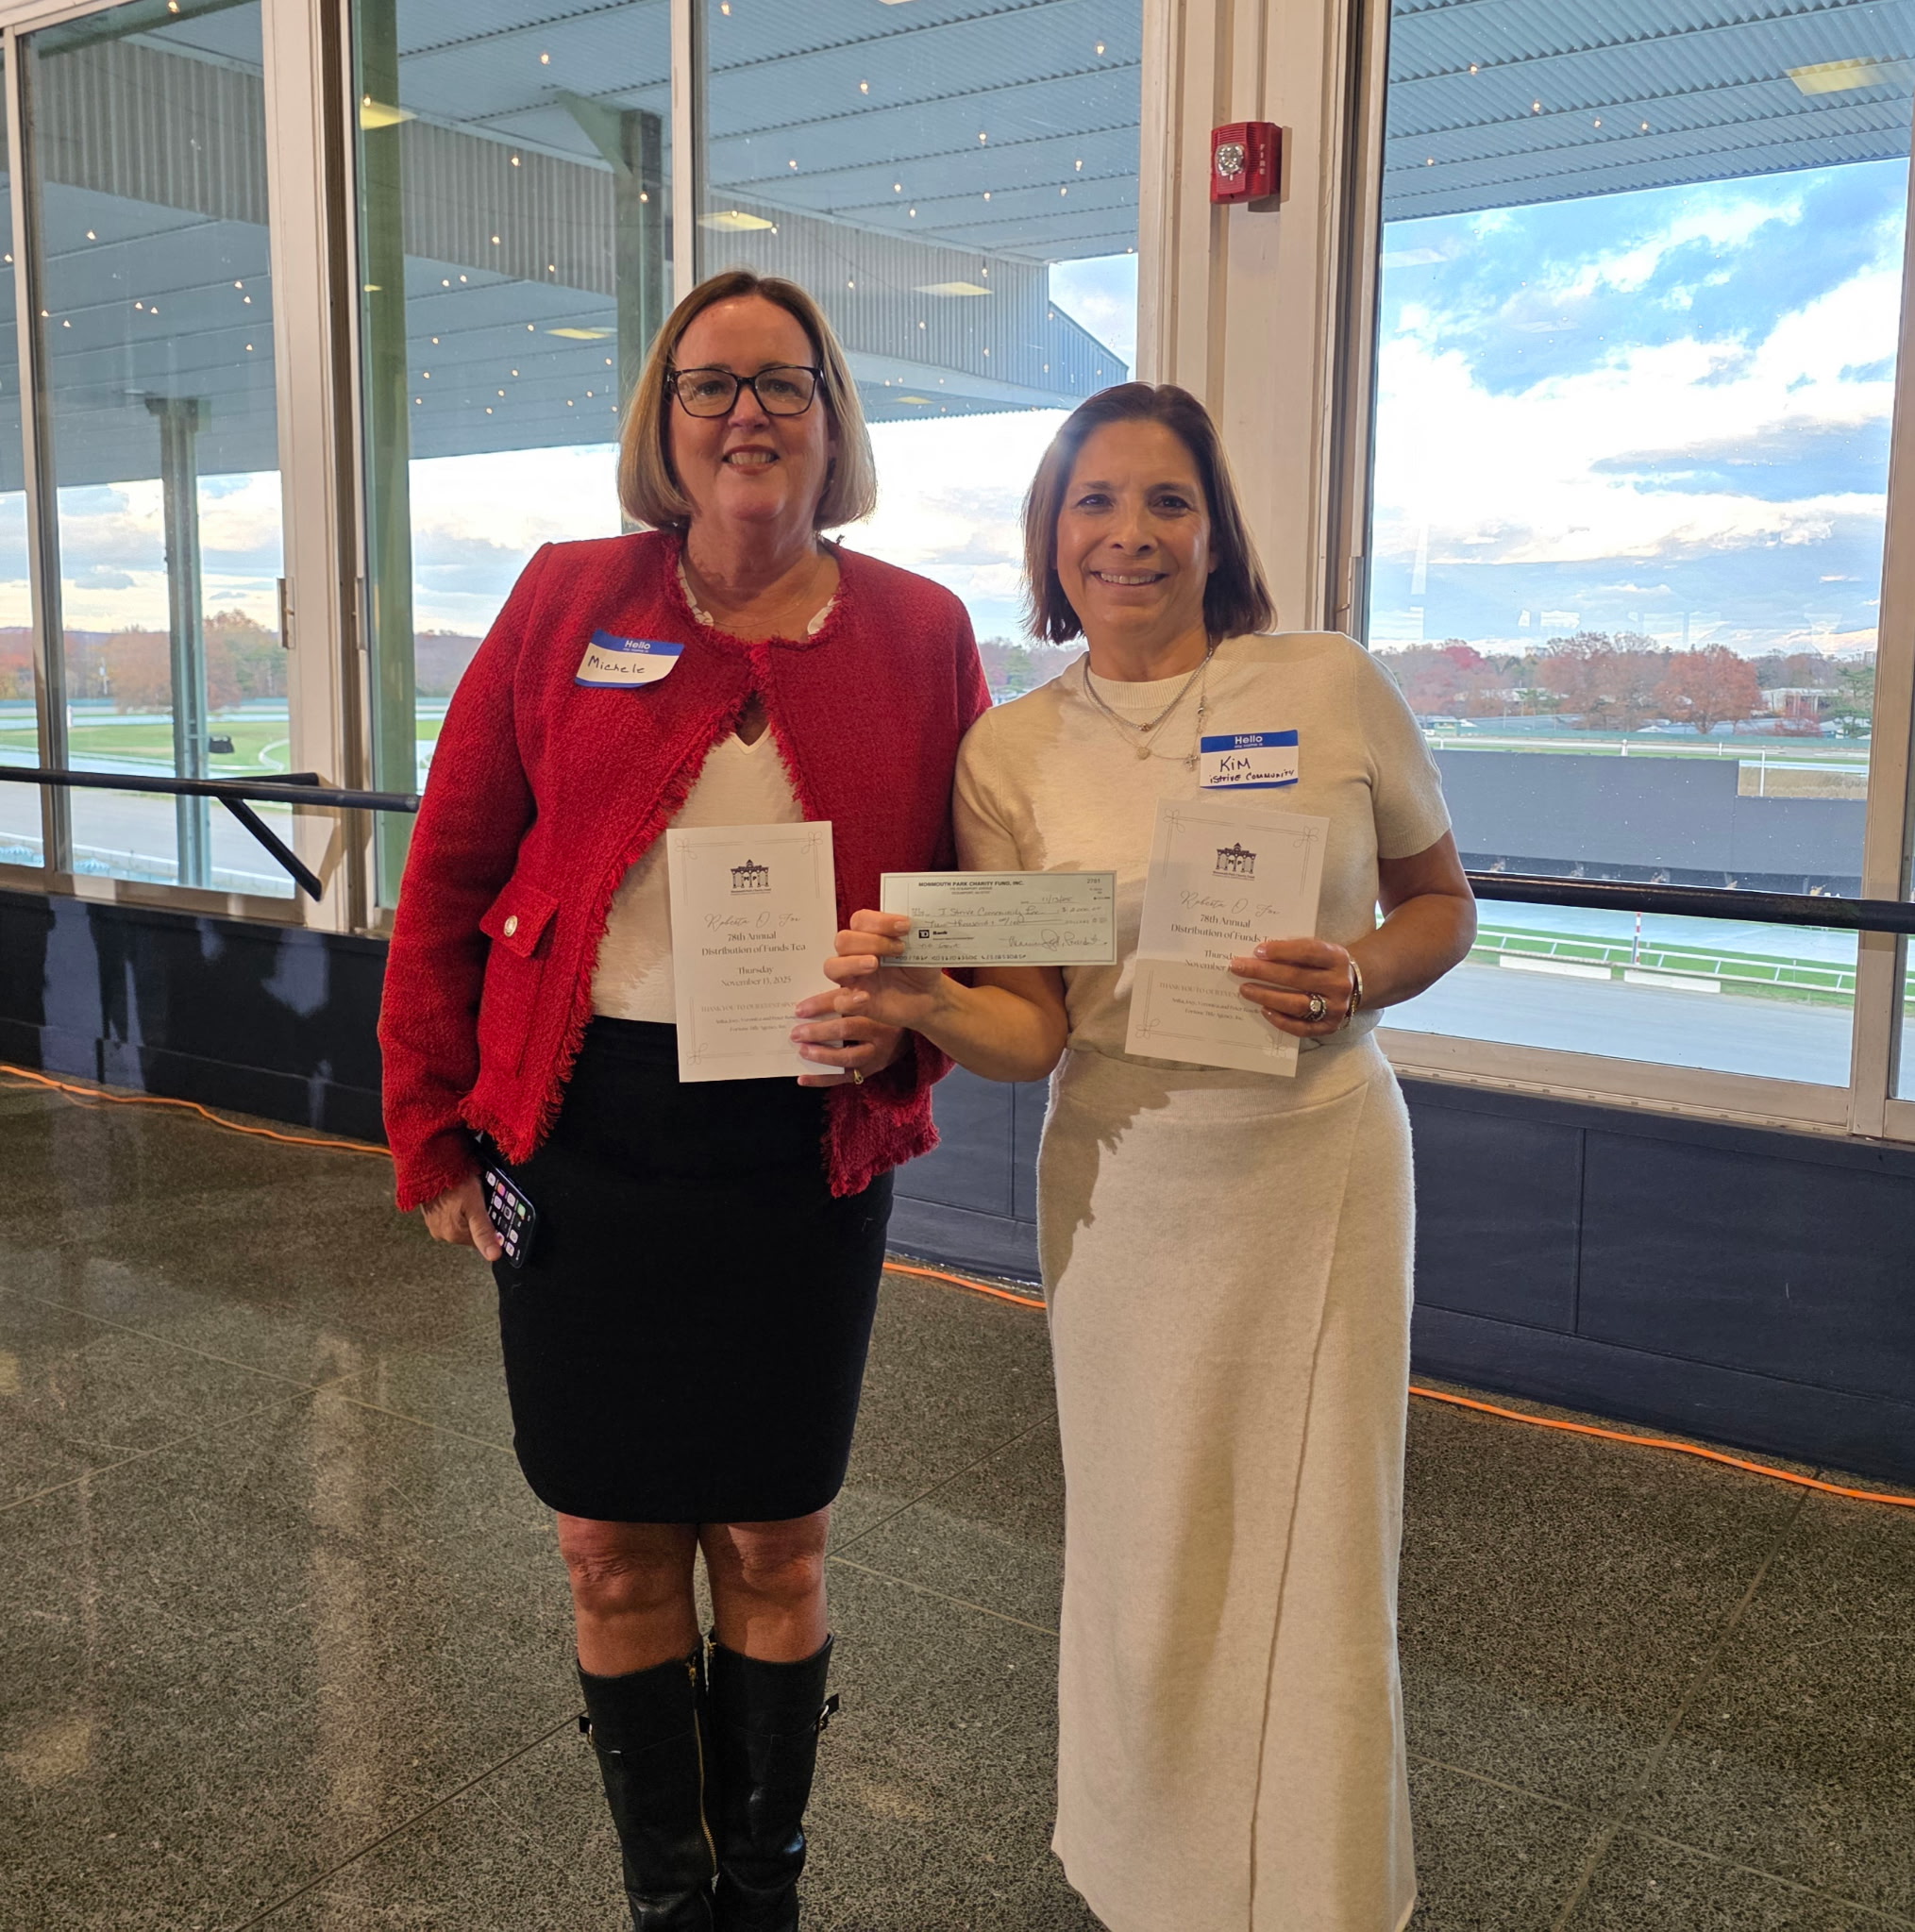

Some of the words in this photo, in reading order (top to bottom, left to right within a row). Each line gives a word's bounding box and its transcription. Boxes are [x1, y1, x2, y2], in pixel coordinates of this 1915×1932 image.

[624, 640, 651, 649] Hello
[587, 655, 646, 674] Michele
[1235, 735, 1263, 745] Hello
[1201, 915, 1218, 923] 78th
[1221, 916, 1251, 928] Annual
[728, 933, 746, 942] 78th
[748, 931, 777, 940] Annual
[1171, 924, 1222, 937] Distribution
[1224, 930, 1235, 939] of
[1235, 932, 1261, 943] Funds
[701, 946, 752, 956] Distribution
[753, 945, 763, 953] of
[764, 944, 789, 952] Funds
[738, 966, 774, 975] Thursday
[1184, 959, 1226, 971] November
[721, 978, 761, 987] November
[774, 976, 792, 984] 2025
